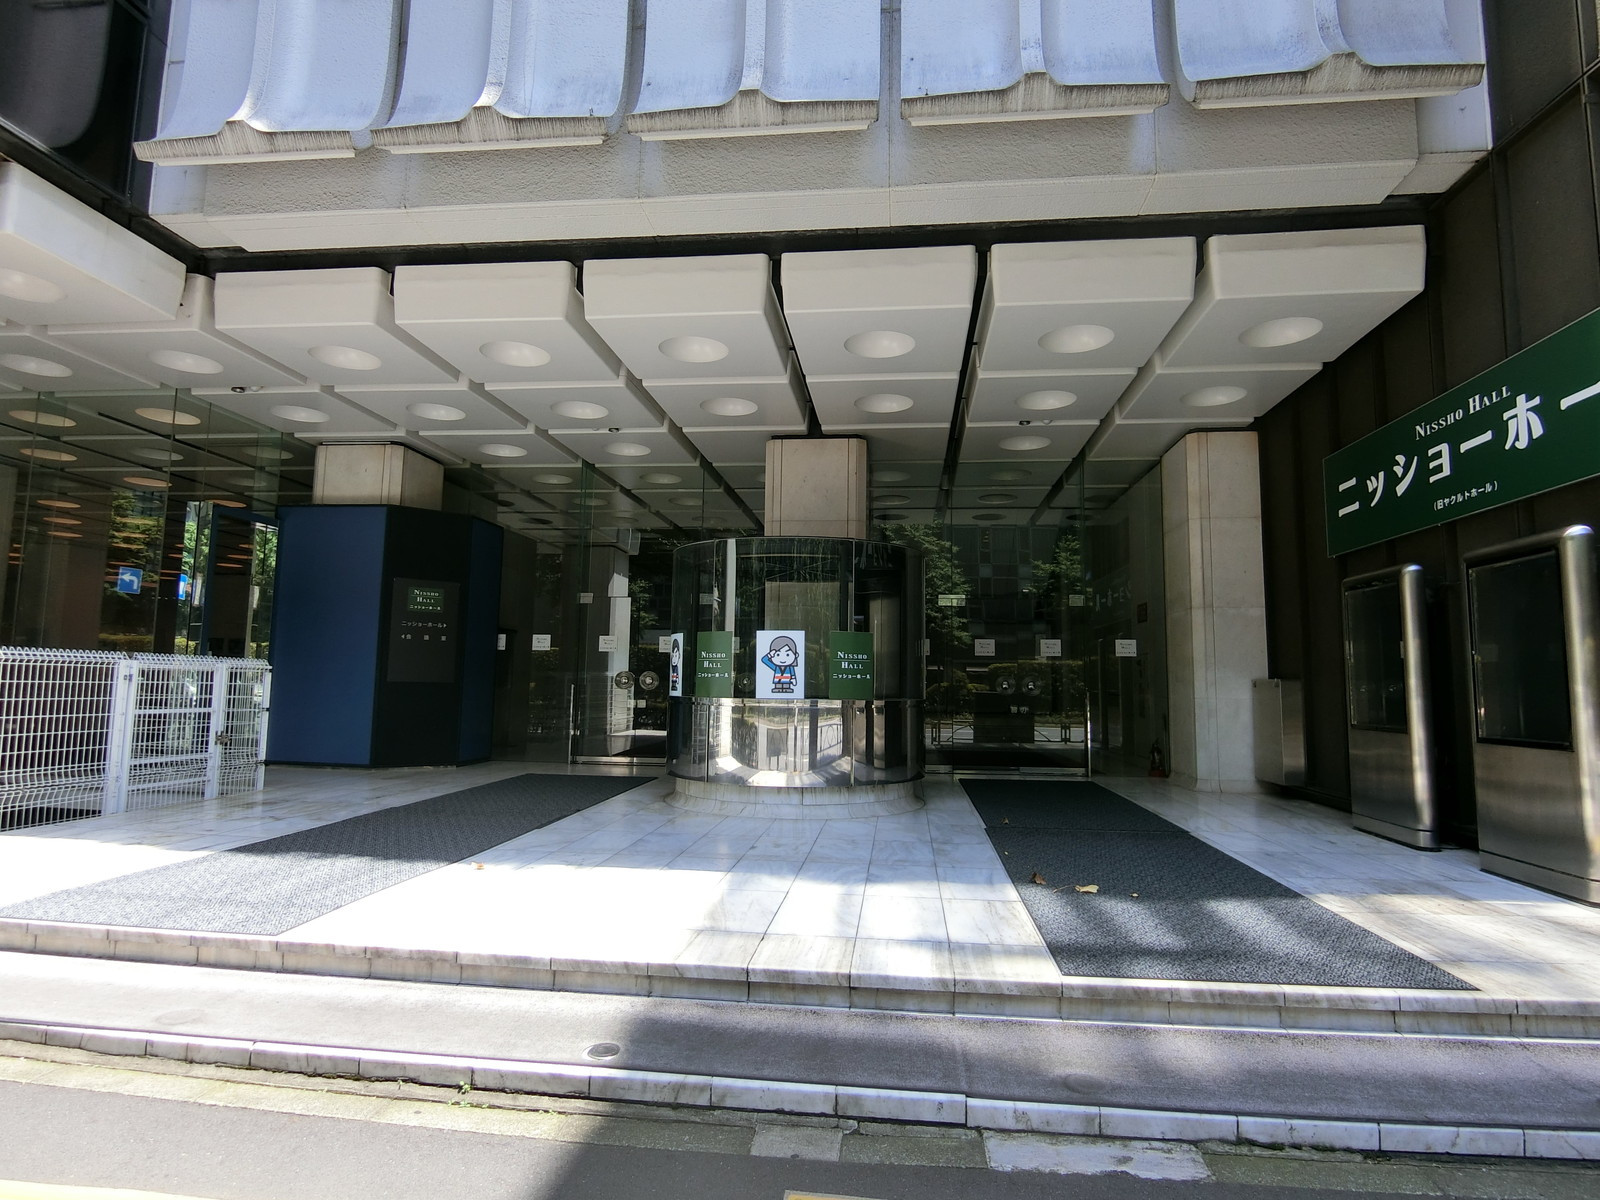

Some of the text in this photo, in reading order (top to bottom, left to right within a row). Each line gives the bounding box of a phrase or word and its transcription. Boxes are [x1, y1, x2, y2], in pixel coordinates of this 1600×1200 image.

[1414, 385, 1511, 440] NISSHO HALL
[837, 651, 868, 659] NISSHO
[703, 660, 722, 668] HALL
[841, 661, 864, 669] HALL
